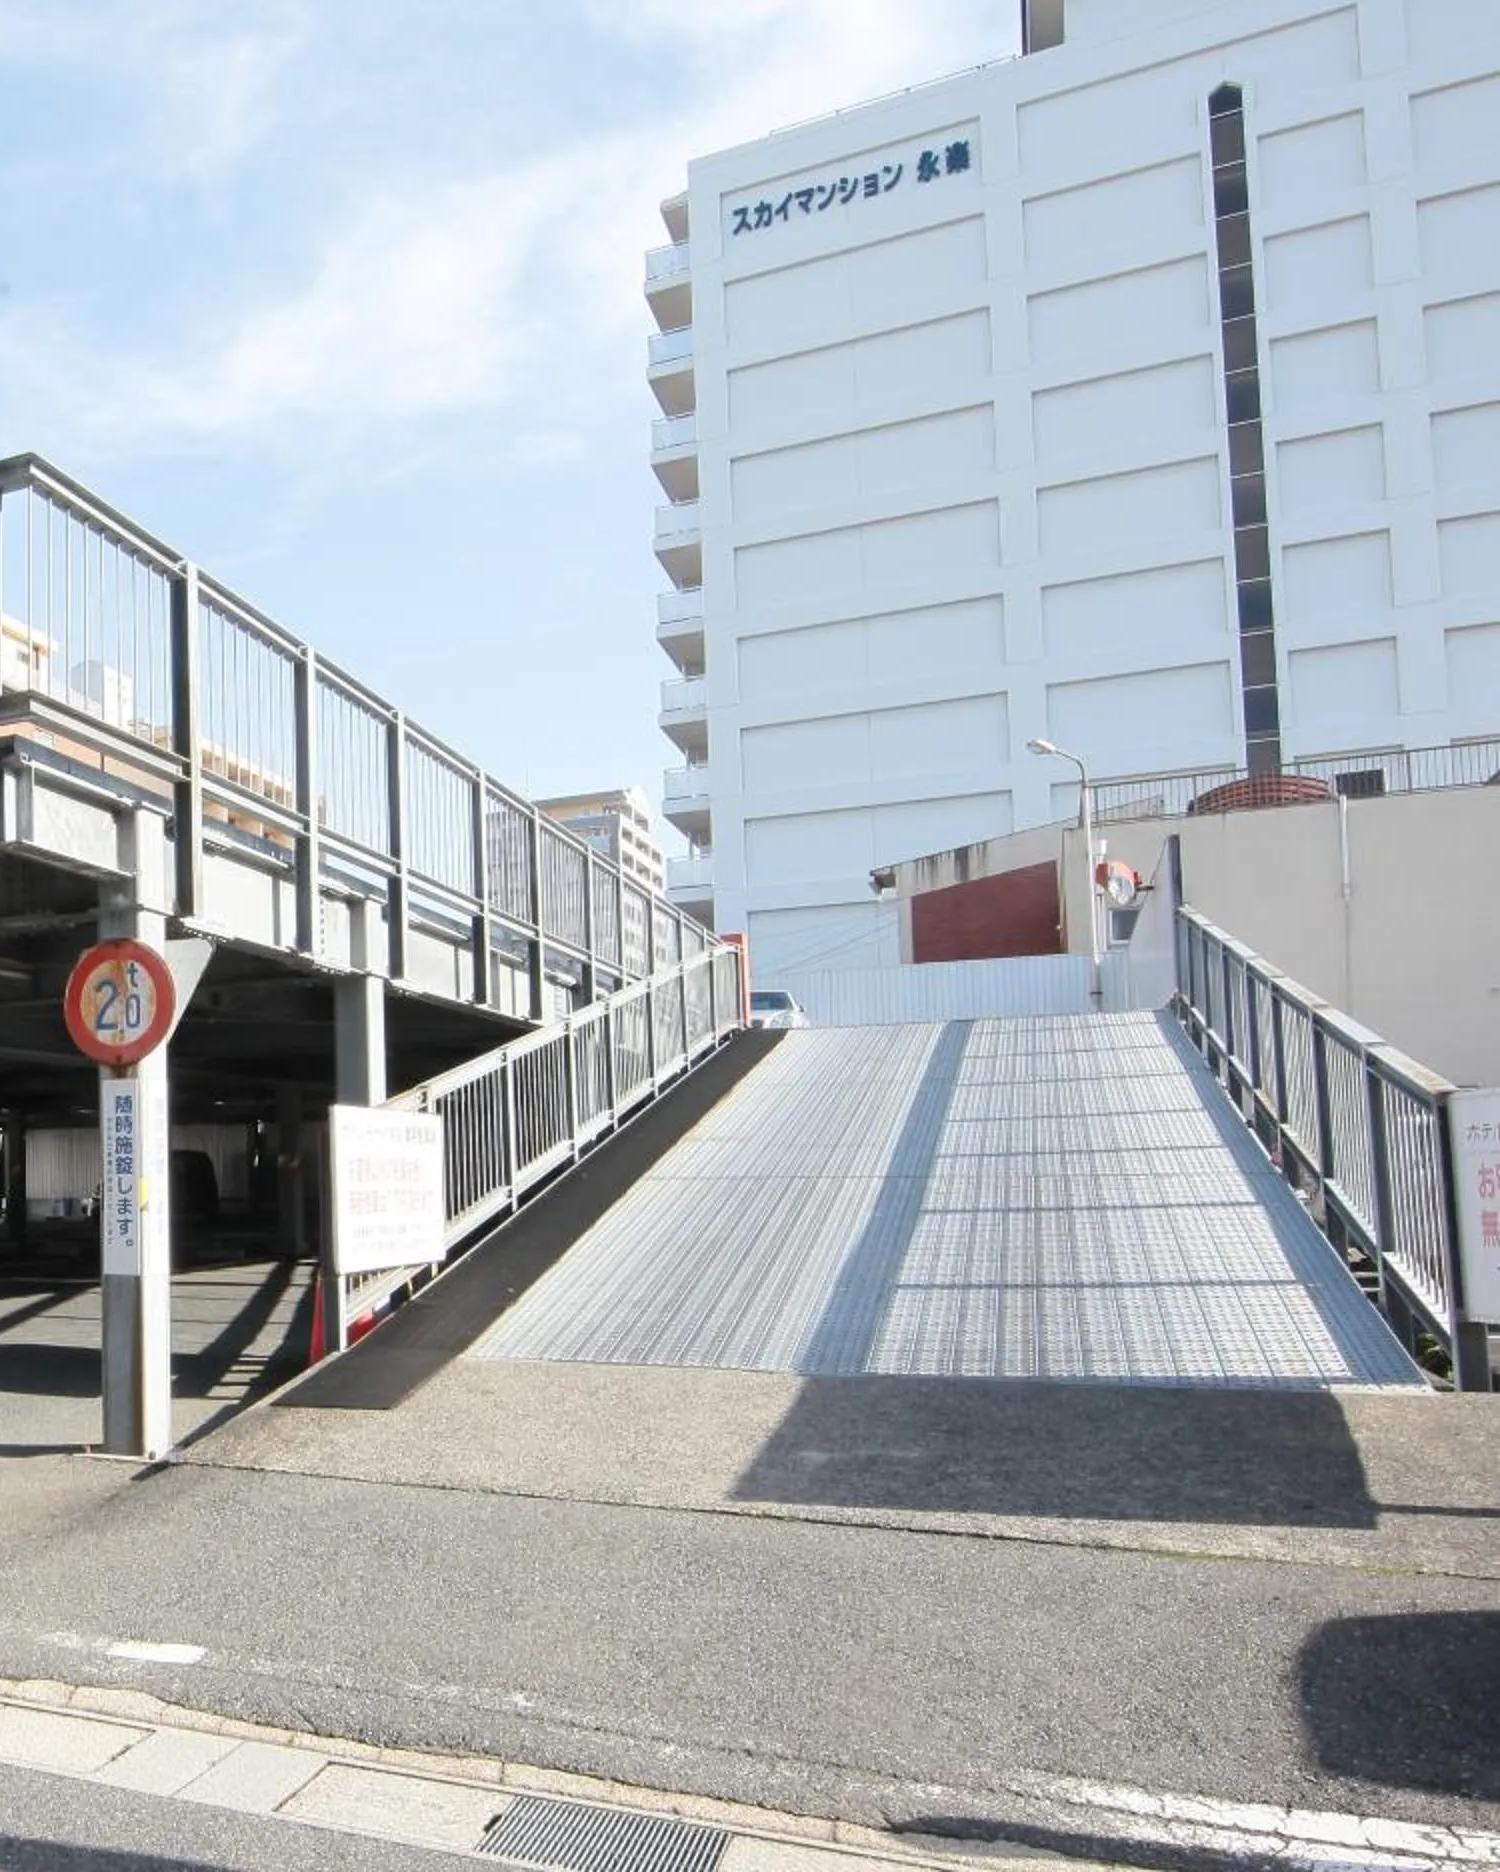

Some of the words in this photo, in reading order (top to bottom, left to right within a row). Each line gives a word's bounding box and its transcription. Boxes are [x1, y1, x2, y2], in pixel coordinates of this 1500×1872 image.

[732, 164, 903, 235] スカイマンション
[126, 962, 140, 988] t
[1478, 1159, 1500, 1199] お
[1482, 1211, 1500, 1248] 無
